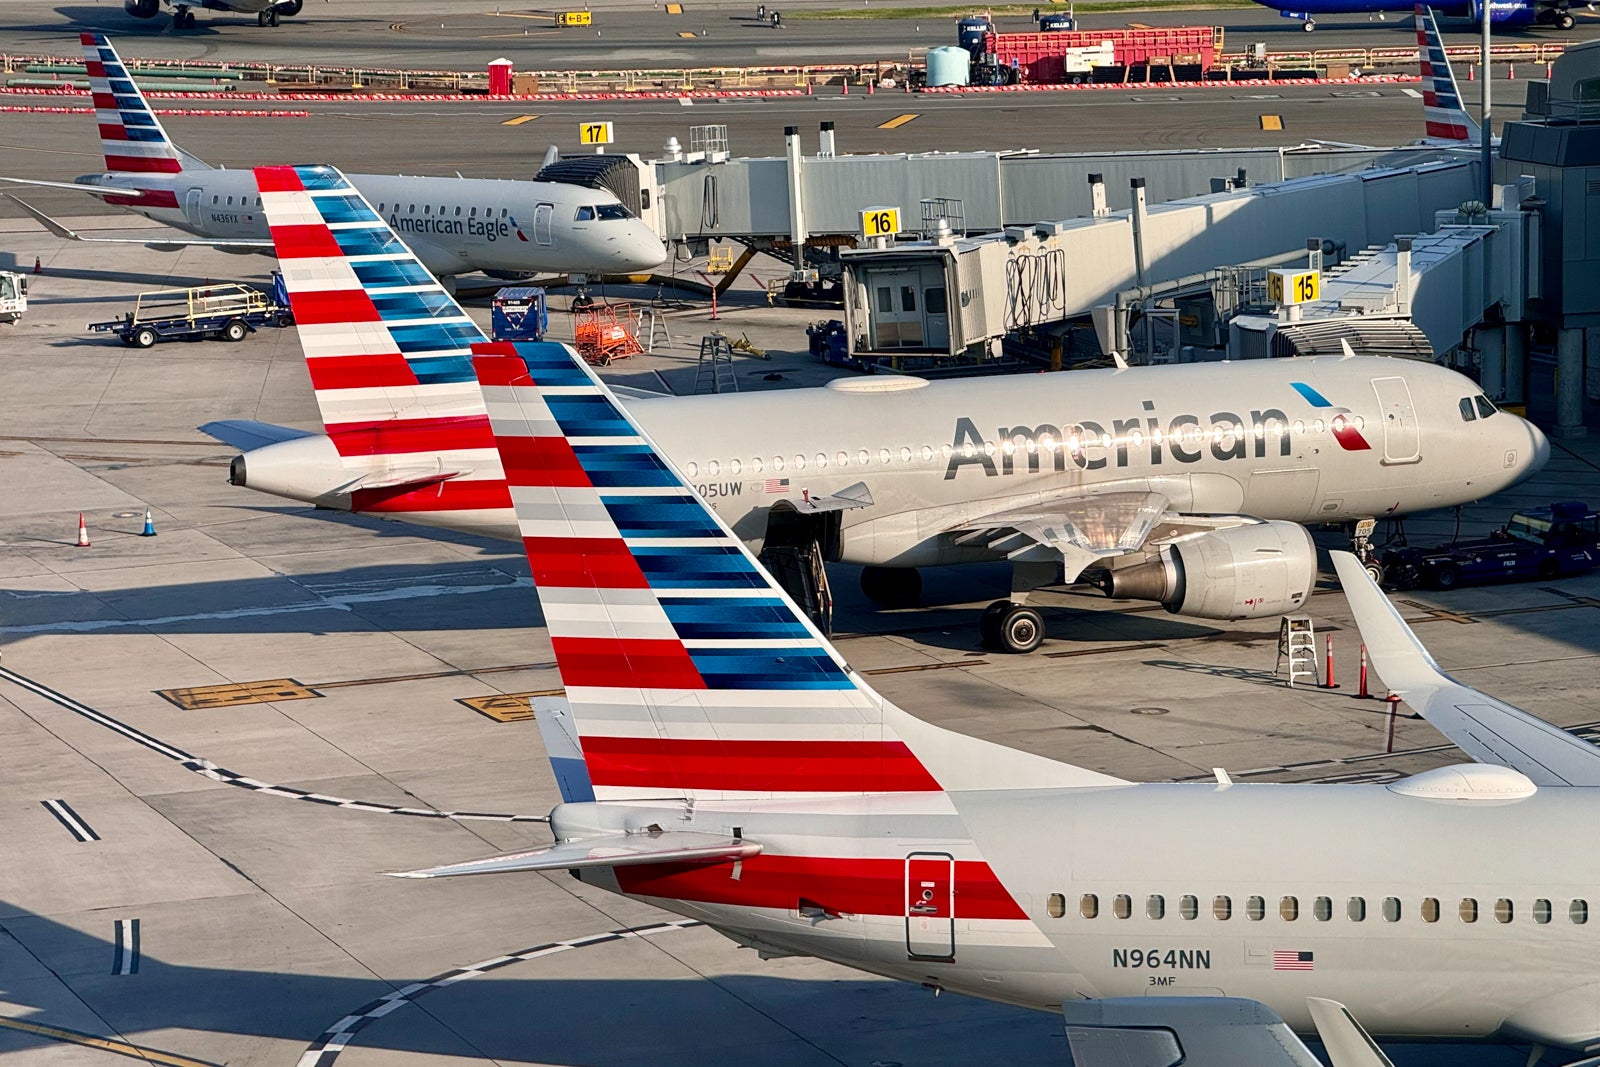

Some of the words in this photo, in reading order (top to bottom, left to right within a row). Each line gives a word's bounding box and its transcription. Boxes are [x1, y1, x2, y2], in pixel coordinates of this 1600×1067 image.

[586, 125, 602, 142] 17
[390, 214, 463, 234] American
[468, 218, 509, 242] Eagle
[871, 212, 891, 234] 16
[1271, 275, 1282, 302] 15
[1298, 275, 1314, 302] 15
[944, 400, 1291, 480] American
[693, 481, 742, 498] 05UW
[1113, 949, 1210, 969] N964NN
[1149, 976, 1176, 986] 3MF
